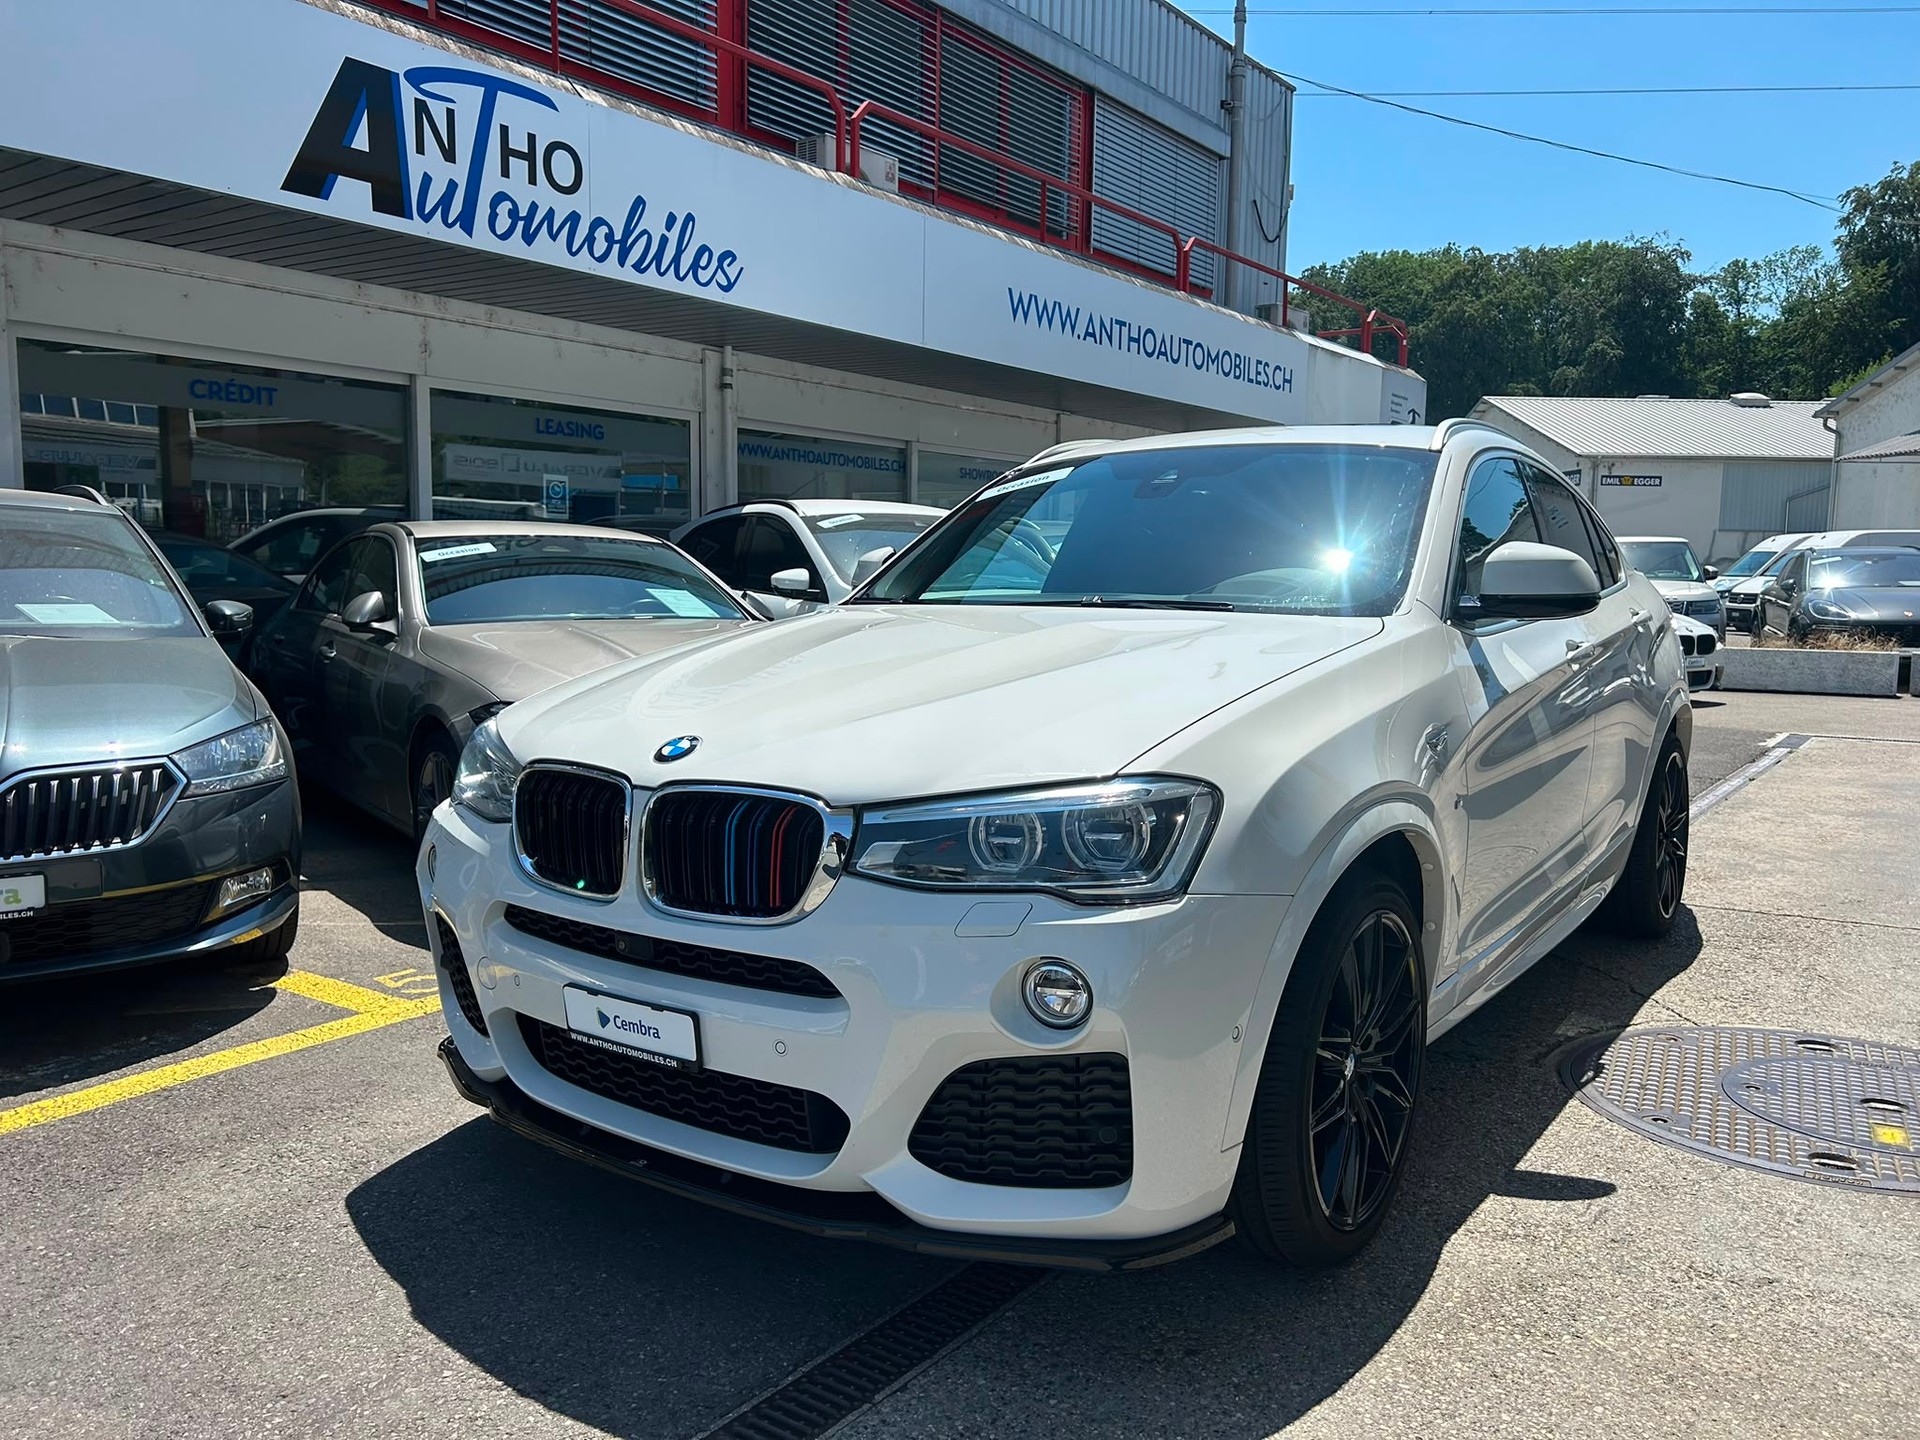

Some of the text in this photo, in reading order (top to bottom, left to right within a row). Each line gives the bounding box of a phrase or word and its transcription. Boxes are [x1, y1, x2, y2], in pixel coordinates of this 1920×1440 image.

[280, 56, 583, 238] ANTHO
[1008, 287, 1293, 394] WWW.ANTHOAUTOMOBILES.CH
[189, 378, 278, 406] CRÉDIT
[535, 417, 605, 440] LEASING
[960, 467, 1004, 480] SHOWRO
[1602, 477, 1660, 486] EMIL EGGER
[437, 546, 480, 557] Occasion
[613, 1014, 661, 1040] Cembra
[569, 1031, 678, 1068] WWW.ANTHOAUTOMOBILES.CH
